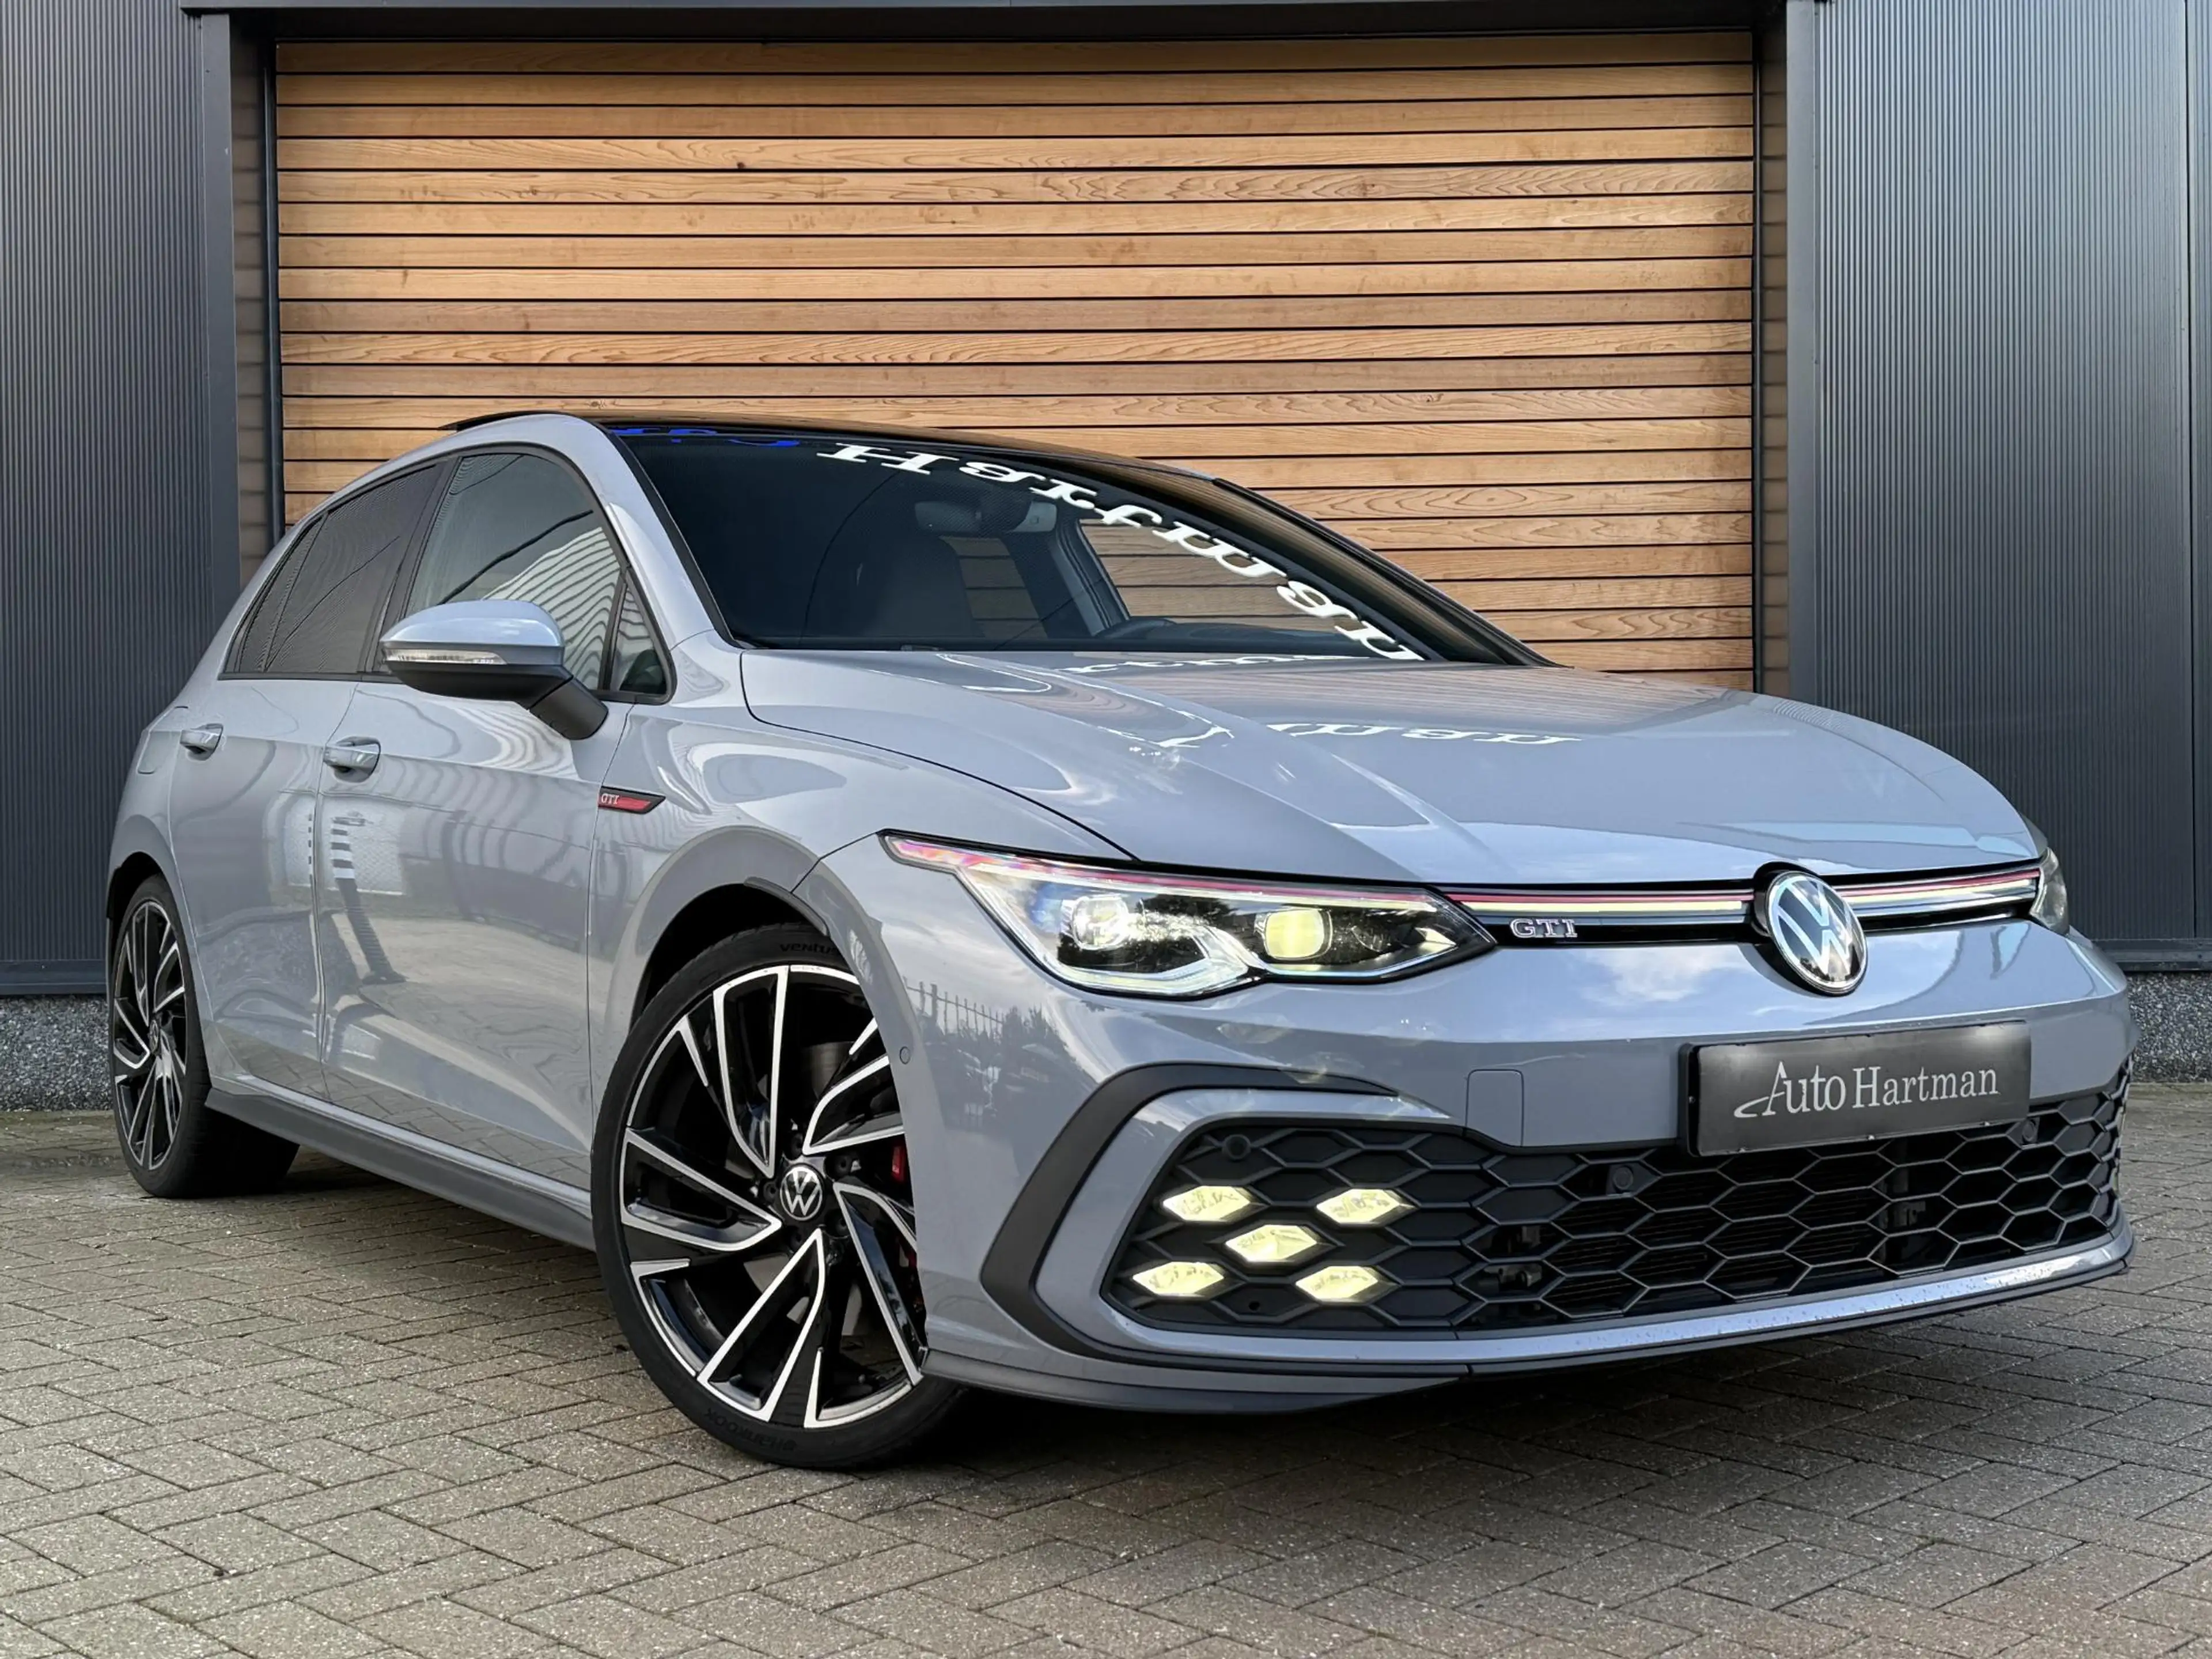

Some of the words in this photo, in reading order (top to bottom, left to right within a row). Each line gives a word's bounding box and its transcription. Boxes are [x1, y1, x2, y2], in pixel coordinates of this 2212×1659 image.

[601, 793, 620, 805] GTI
[1510, 918, 1578, 938] GTI
[1734, 1060, 1846, 1118] Auto
[1852, 1066, 1998, 1109] Hartman
